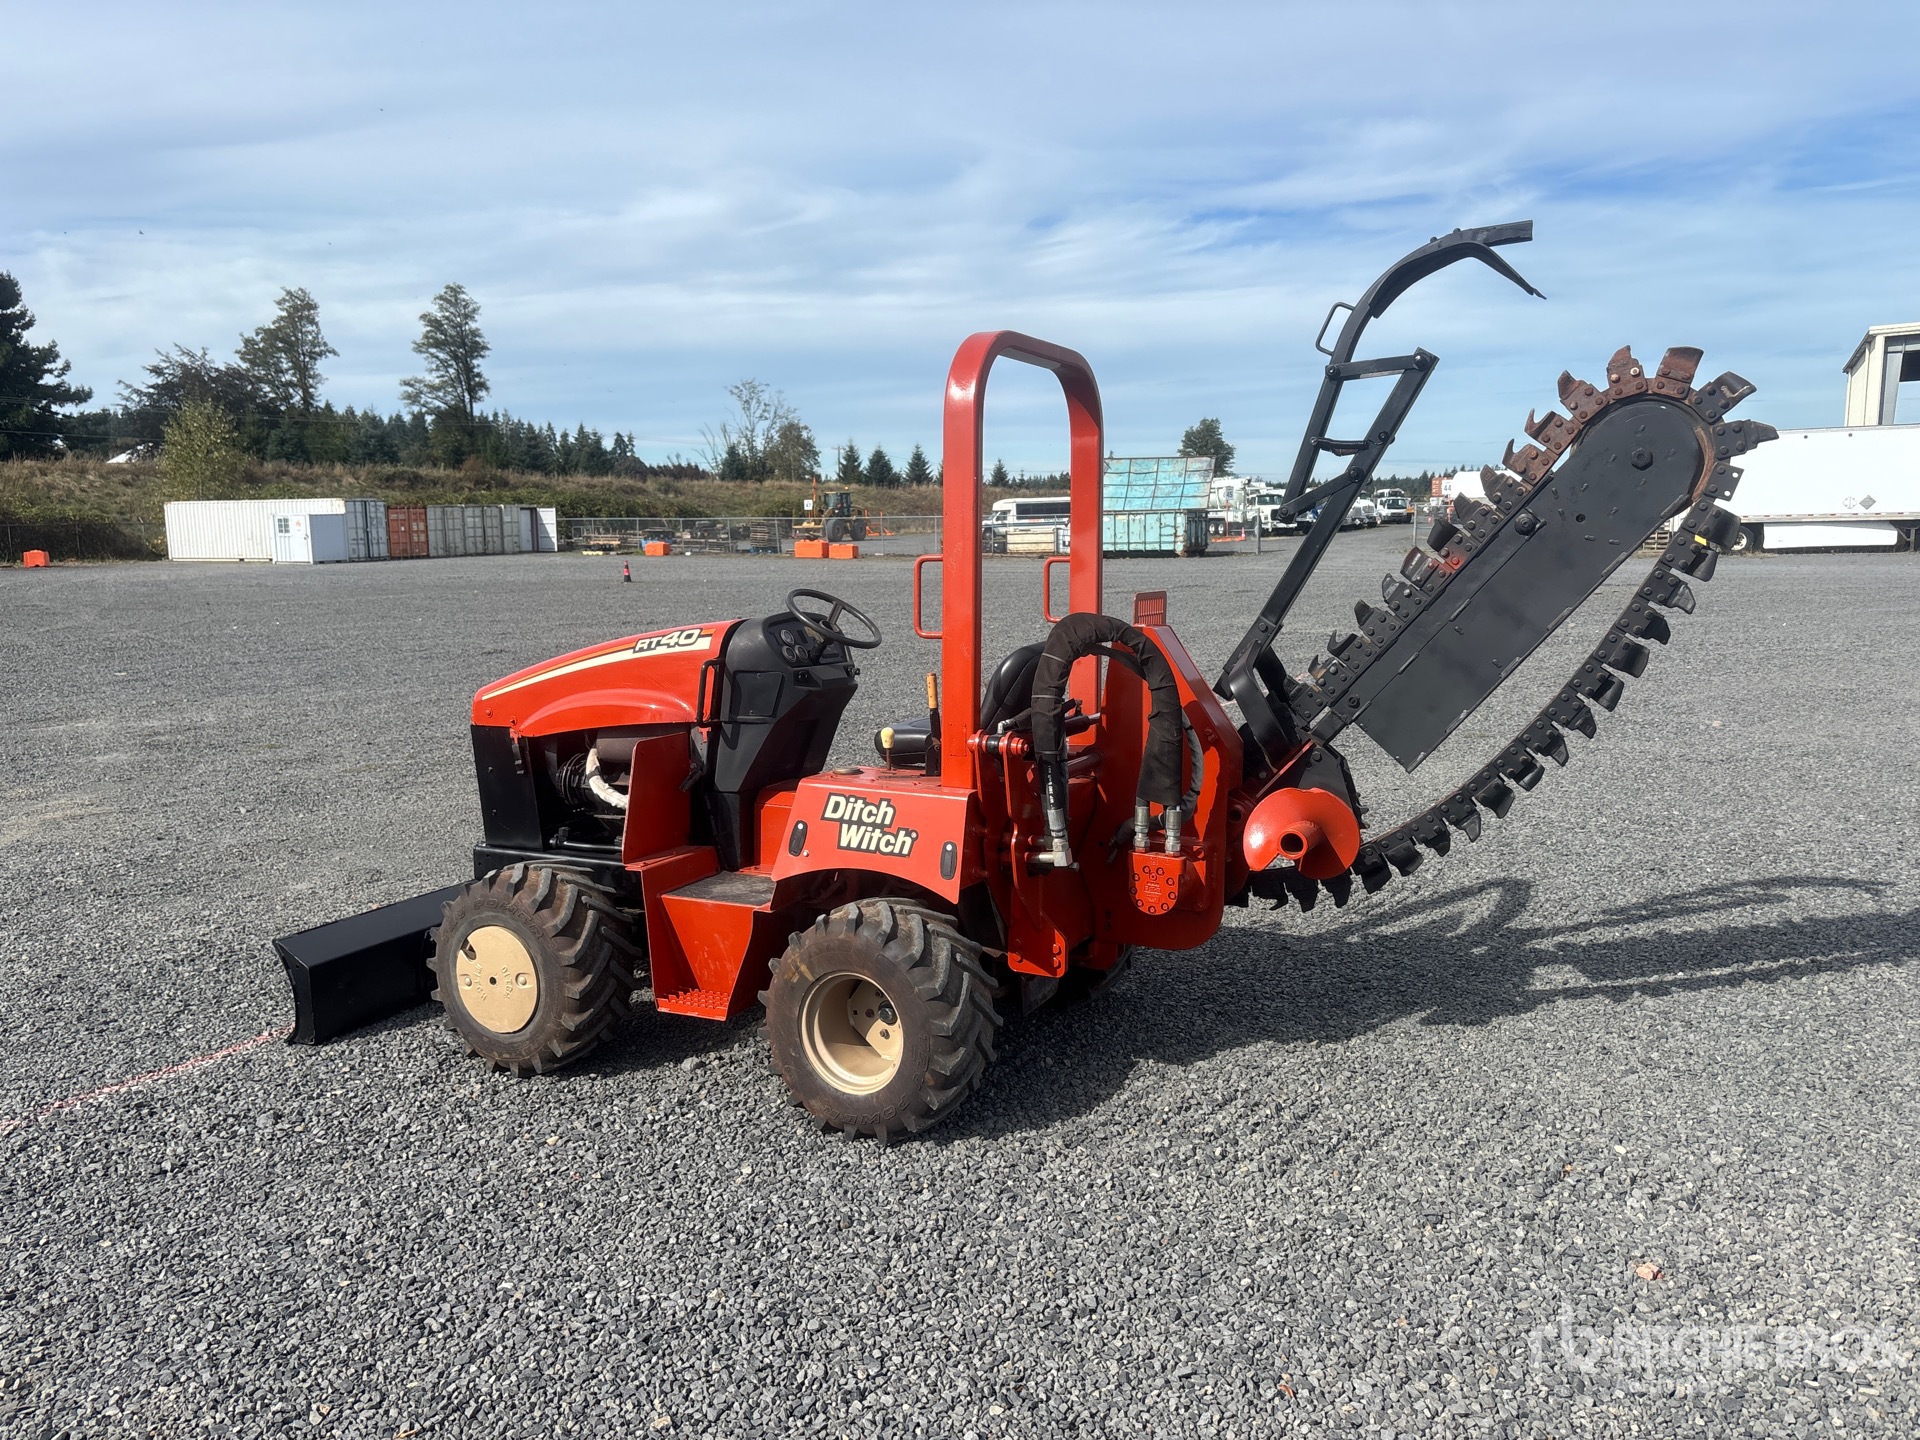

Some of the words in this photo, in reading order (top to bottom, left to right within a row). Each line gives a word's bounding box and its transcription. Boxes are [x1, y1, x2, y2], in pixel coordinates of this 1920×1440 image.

[634, 628, 702, 652] RT40
[823, 794, 895, 826] Ditch
[822, 1093, 911, 1126] POWER
